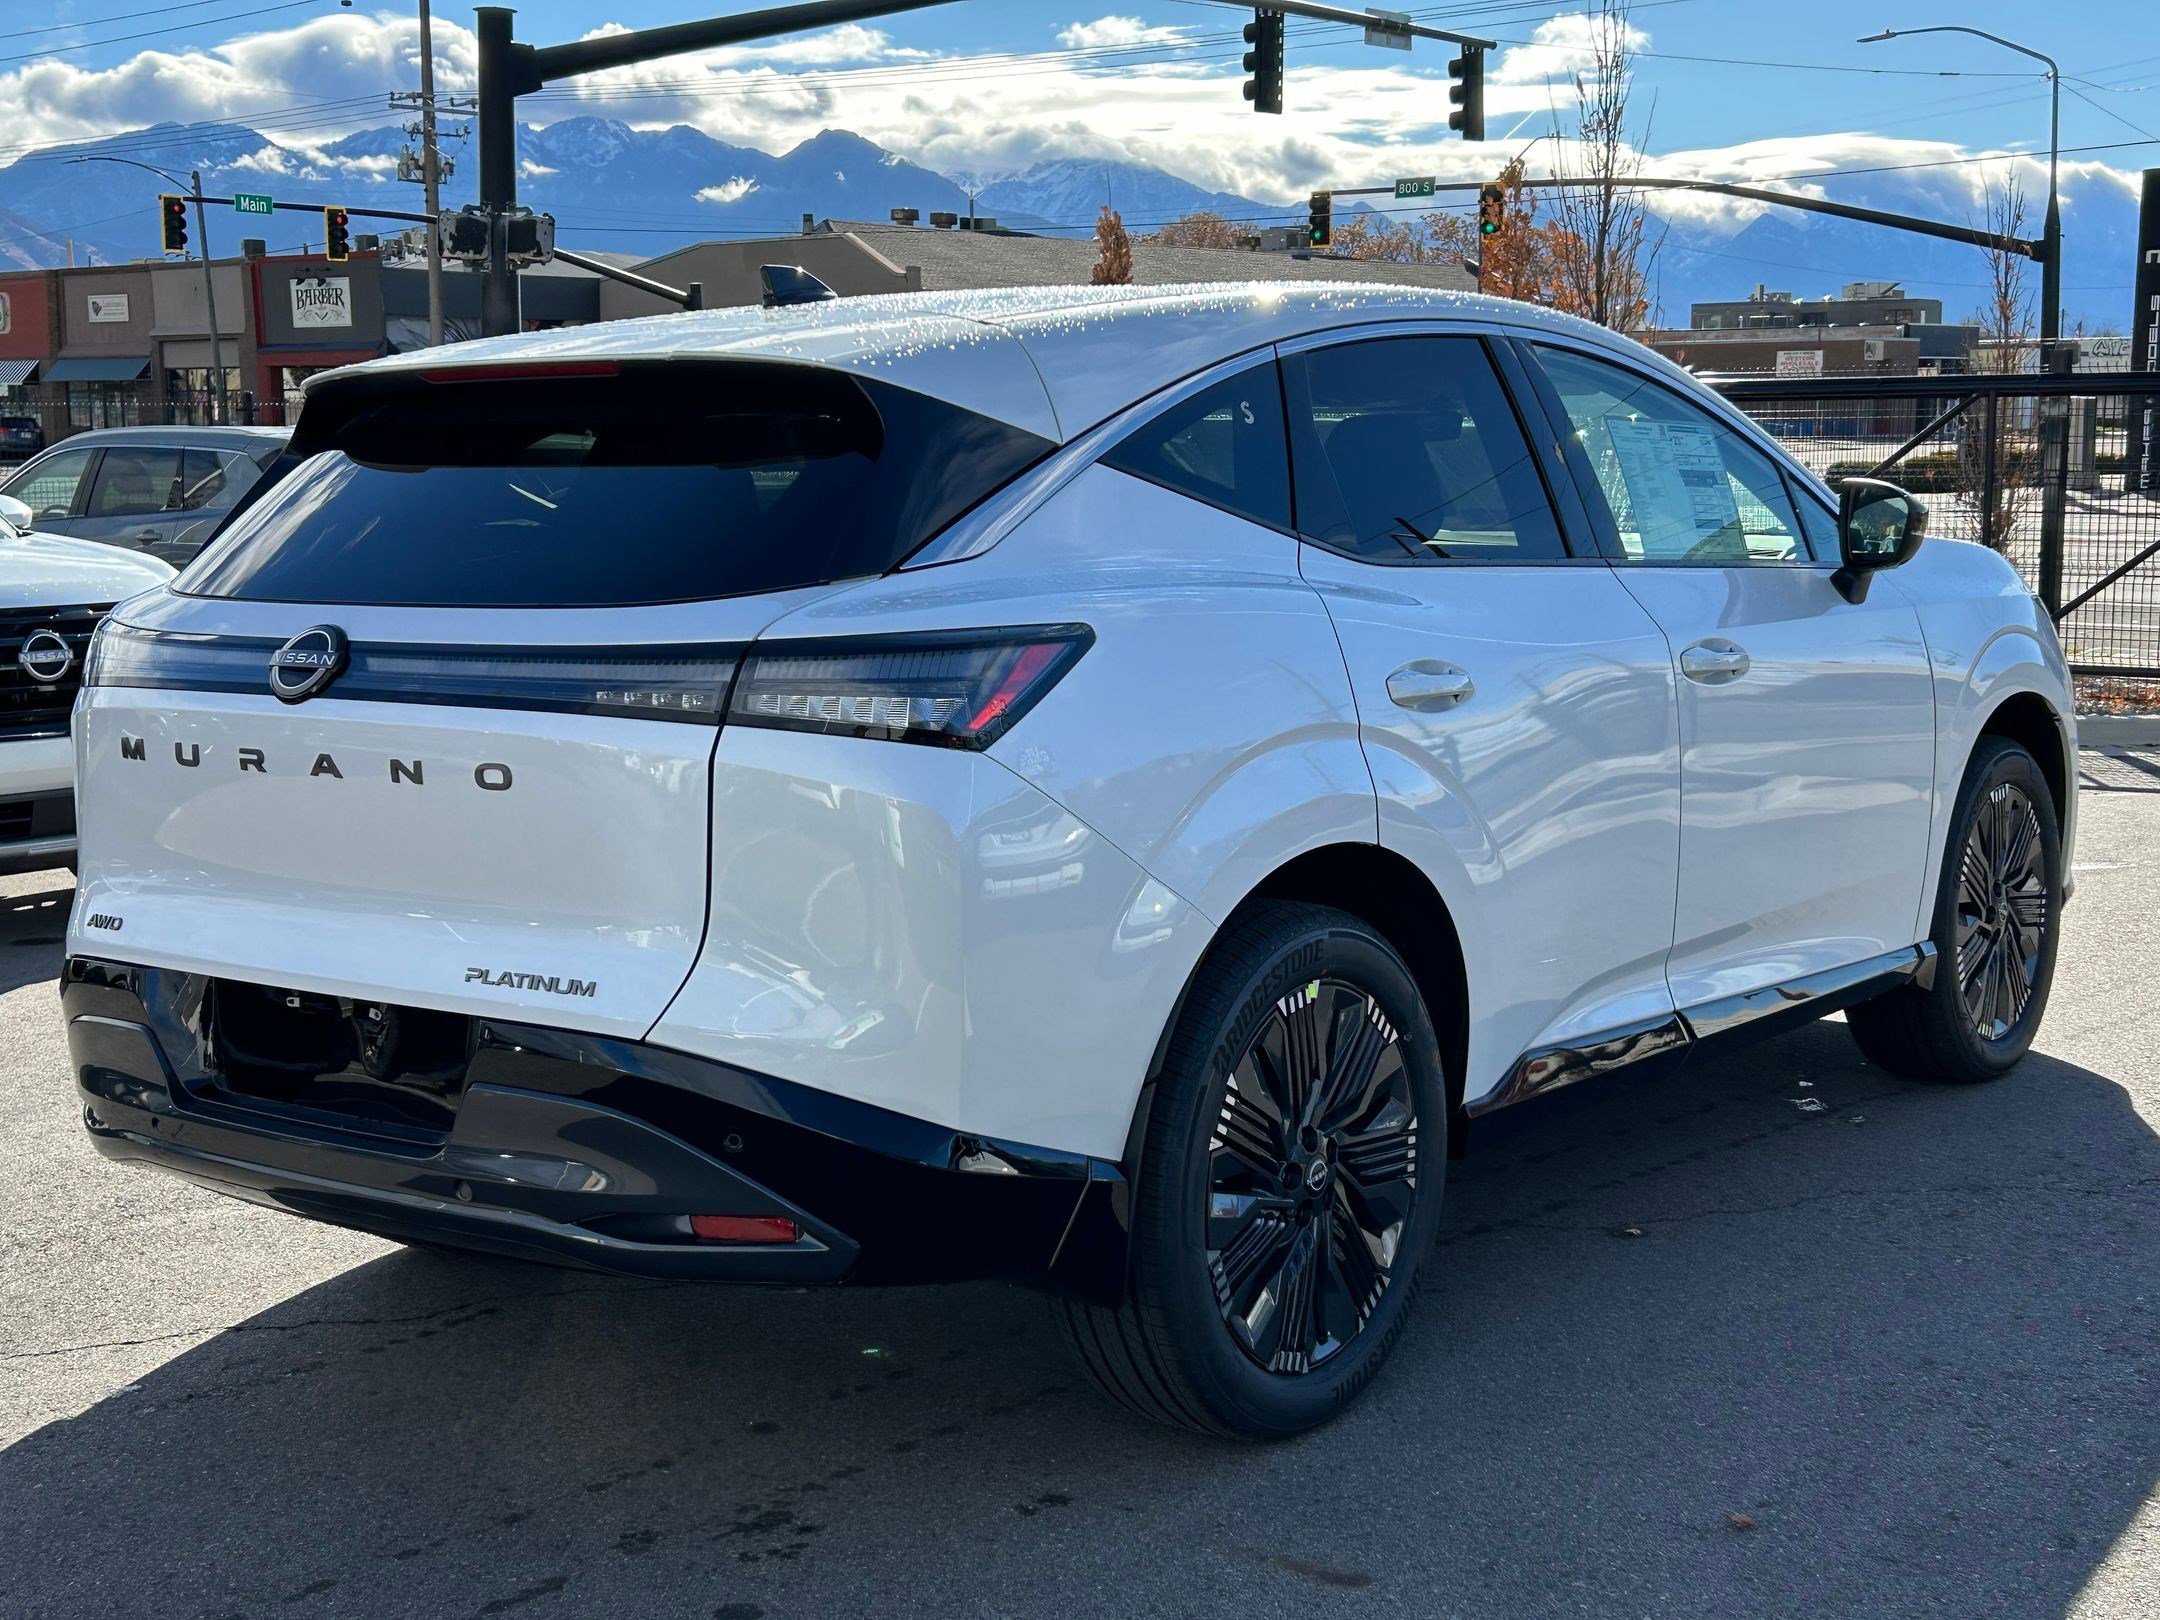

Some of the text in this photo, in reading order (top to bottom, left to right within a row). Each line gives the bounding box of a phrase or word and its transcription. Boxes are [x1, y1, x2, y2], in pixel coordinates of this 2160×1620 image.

[1398, 182, 1418, 194] 800
[240, 198, 267, 213] Main
[295, 287, 345, 310] BARBER
[19, 651, 74, 663] NISSAN
[273, 652, 335, 666] NISSAN
[121, 736, 514, 792] MURANO
[86, 912, 124, 931] AWD
[464, 967, 597, 998] PLATINUM
